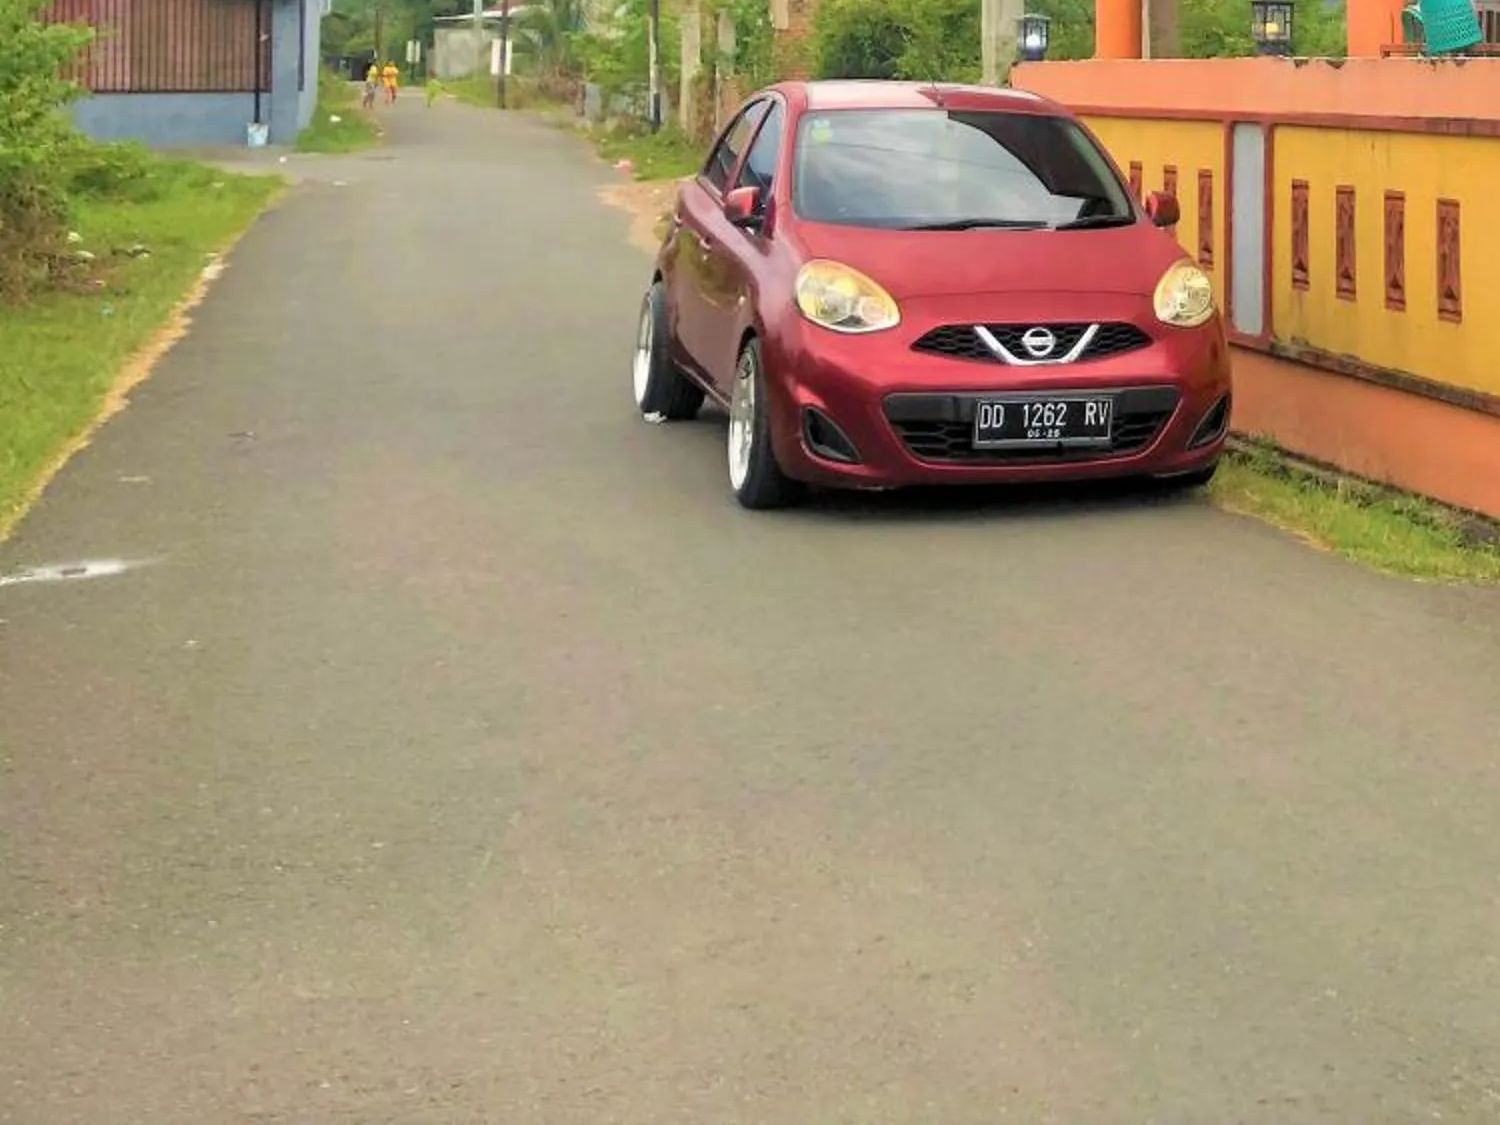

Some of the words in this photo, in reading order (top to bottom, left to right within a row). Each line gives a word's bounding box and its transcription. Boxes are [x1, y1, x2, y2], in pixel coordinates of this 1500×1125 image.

[979, 404, 1005, 429] DD
[1023, 402, 1067, 428] 1262
[1084, 402, 1109, 426] RV
